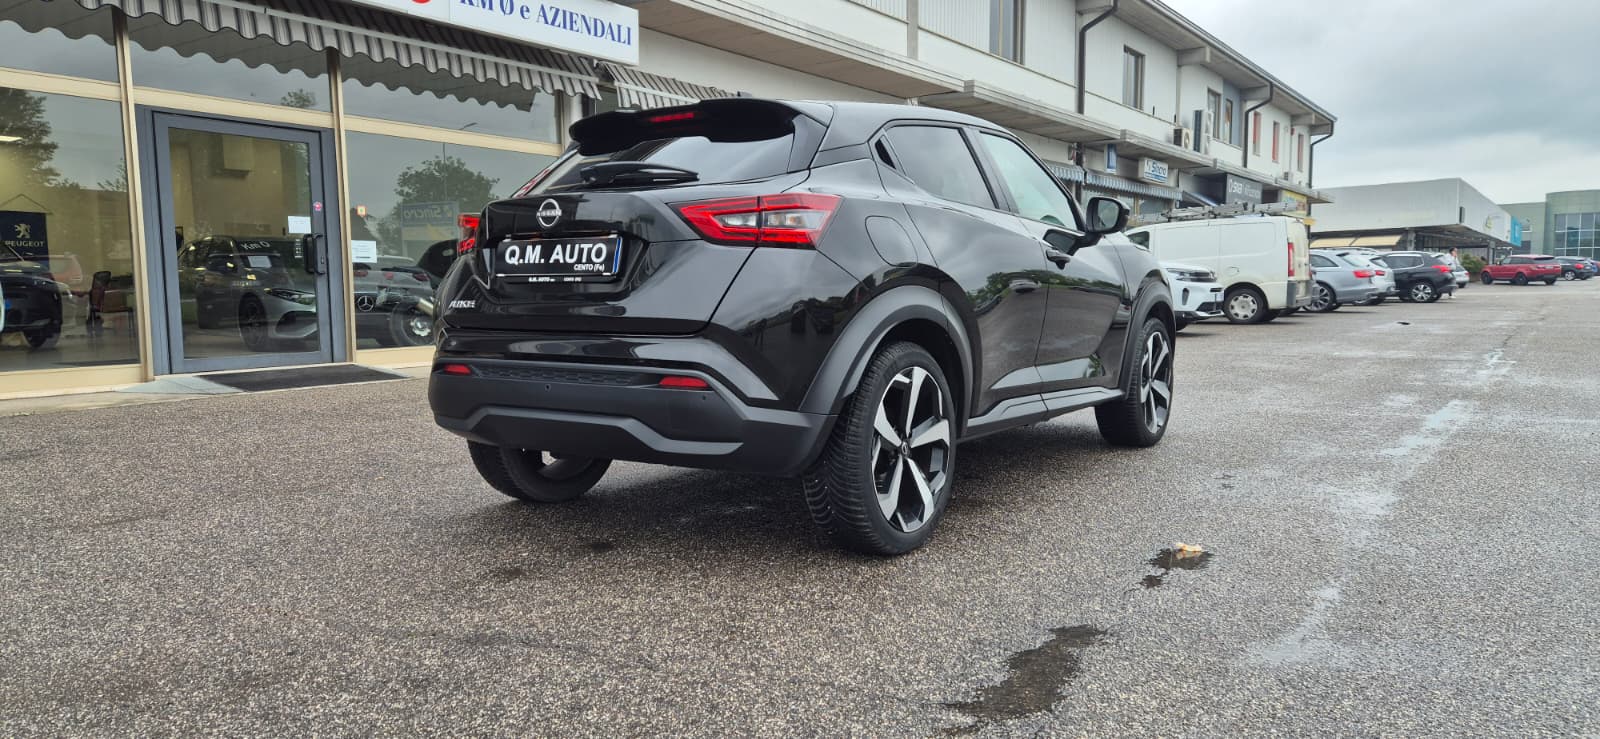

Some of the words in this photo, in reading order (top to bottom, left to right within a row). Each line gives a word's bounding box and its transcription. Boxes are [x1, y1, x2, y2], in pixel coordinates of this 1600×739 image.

[519, 4, 531, 20] e
[536, 3, 632, 46] AZIENDALI
[504, 244, 545, 266] Q.M.
[549, 242, 607, 264] AUTO
[573, 263, 594, 272] CENTO
